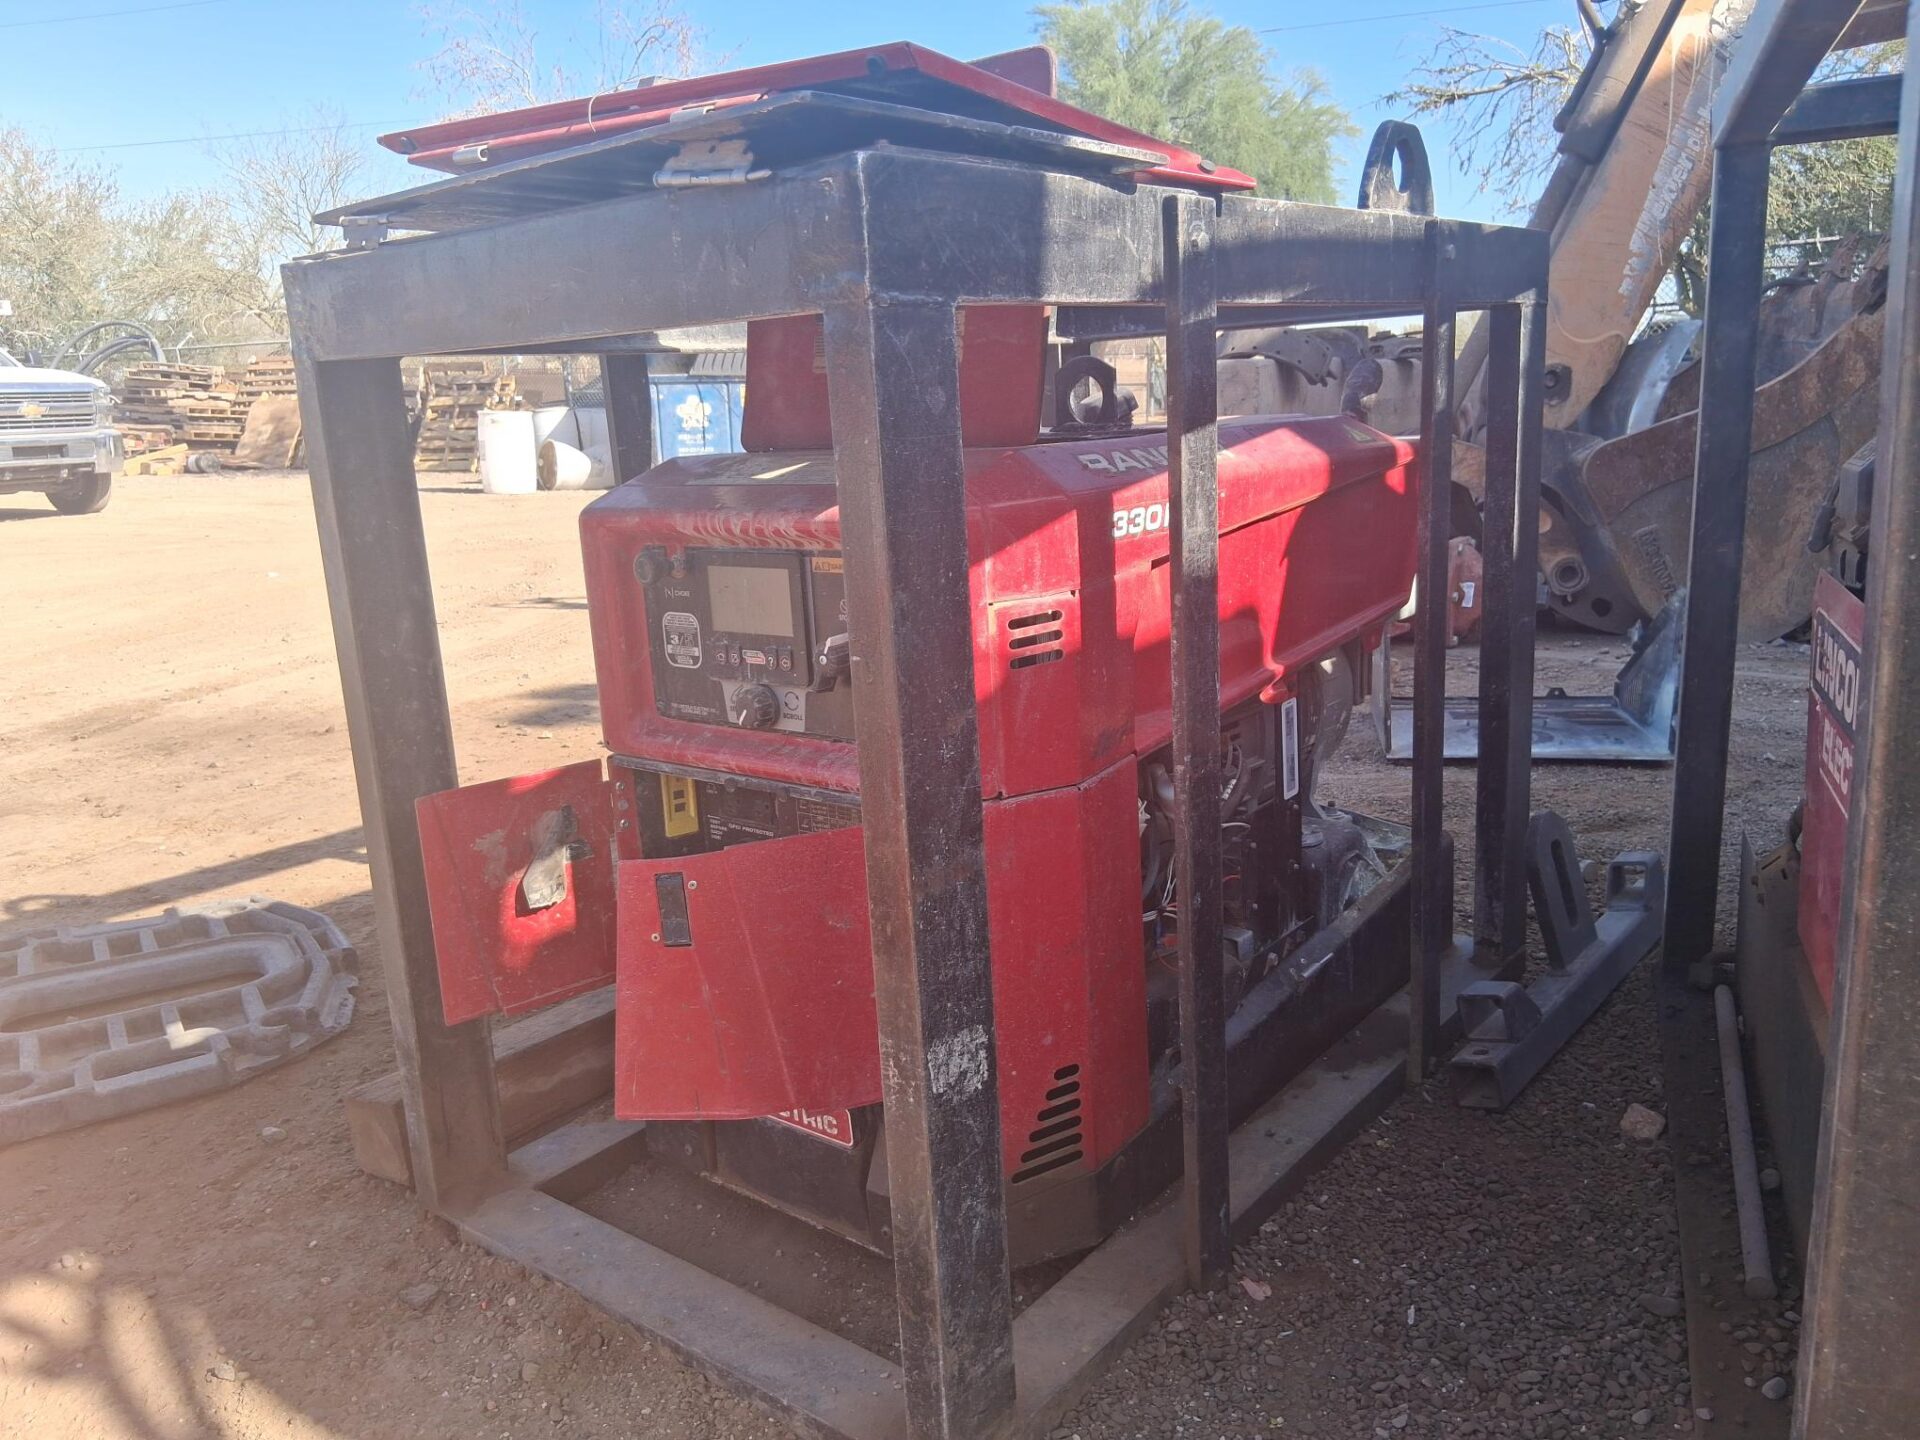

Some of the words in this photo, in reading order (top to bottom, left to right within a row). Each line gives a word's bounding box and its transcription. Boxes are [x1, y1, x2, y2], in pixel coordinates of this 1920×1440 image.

[1078, 445, 1168, 472] RAN
[1113, 502, 1169, 538] 330
[1822, 720, 1854, 795] ELEC
[779, 1108, 838, 1135] TRIC
